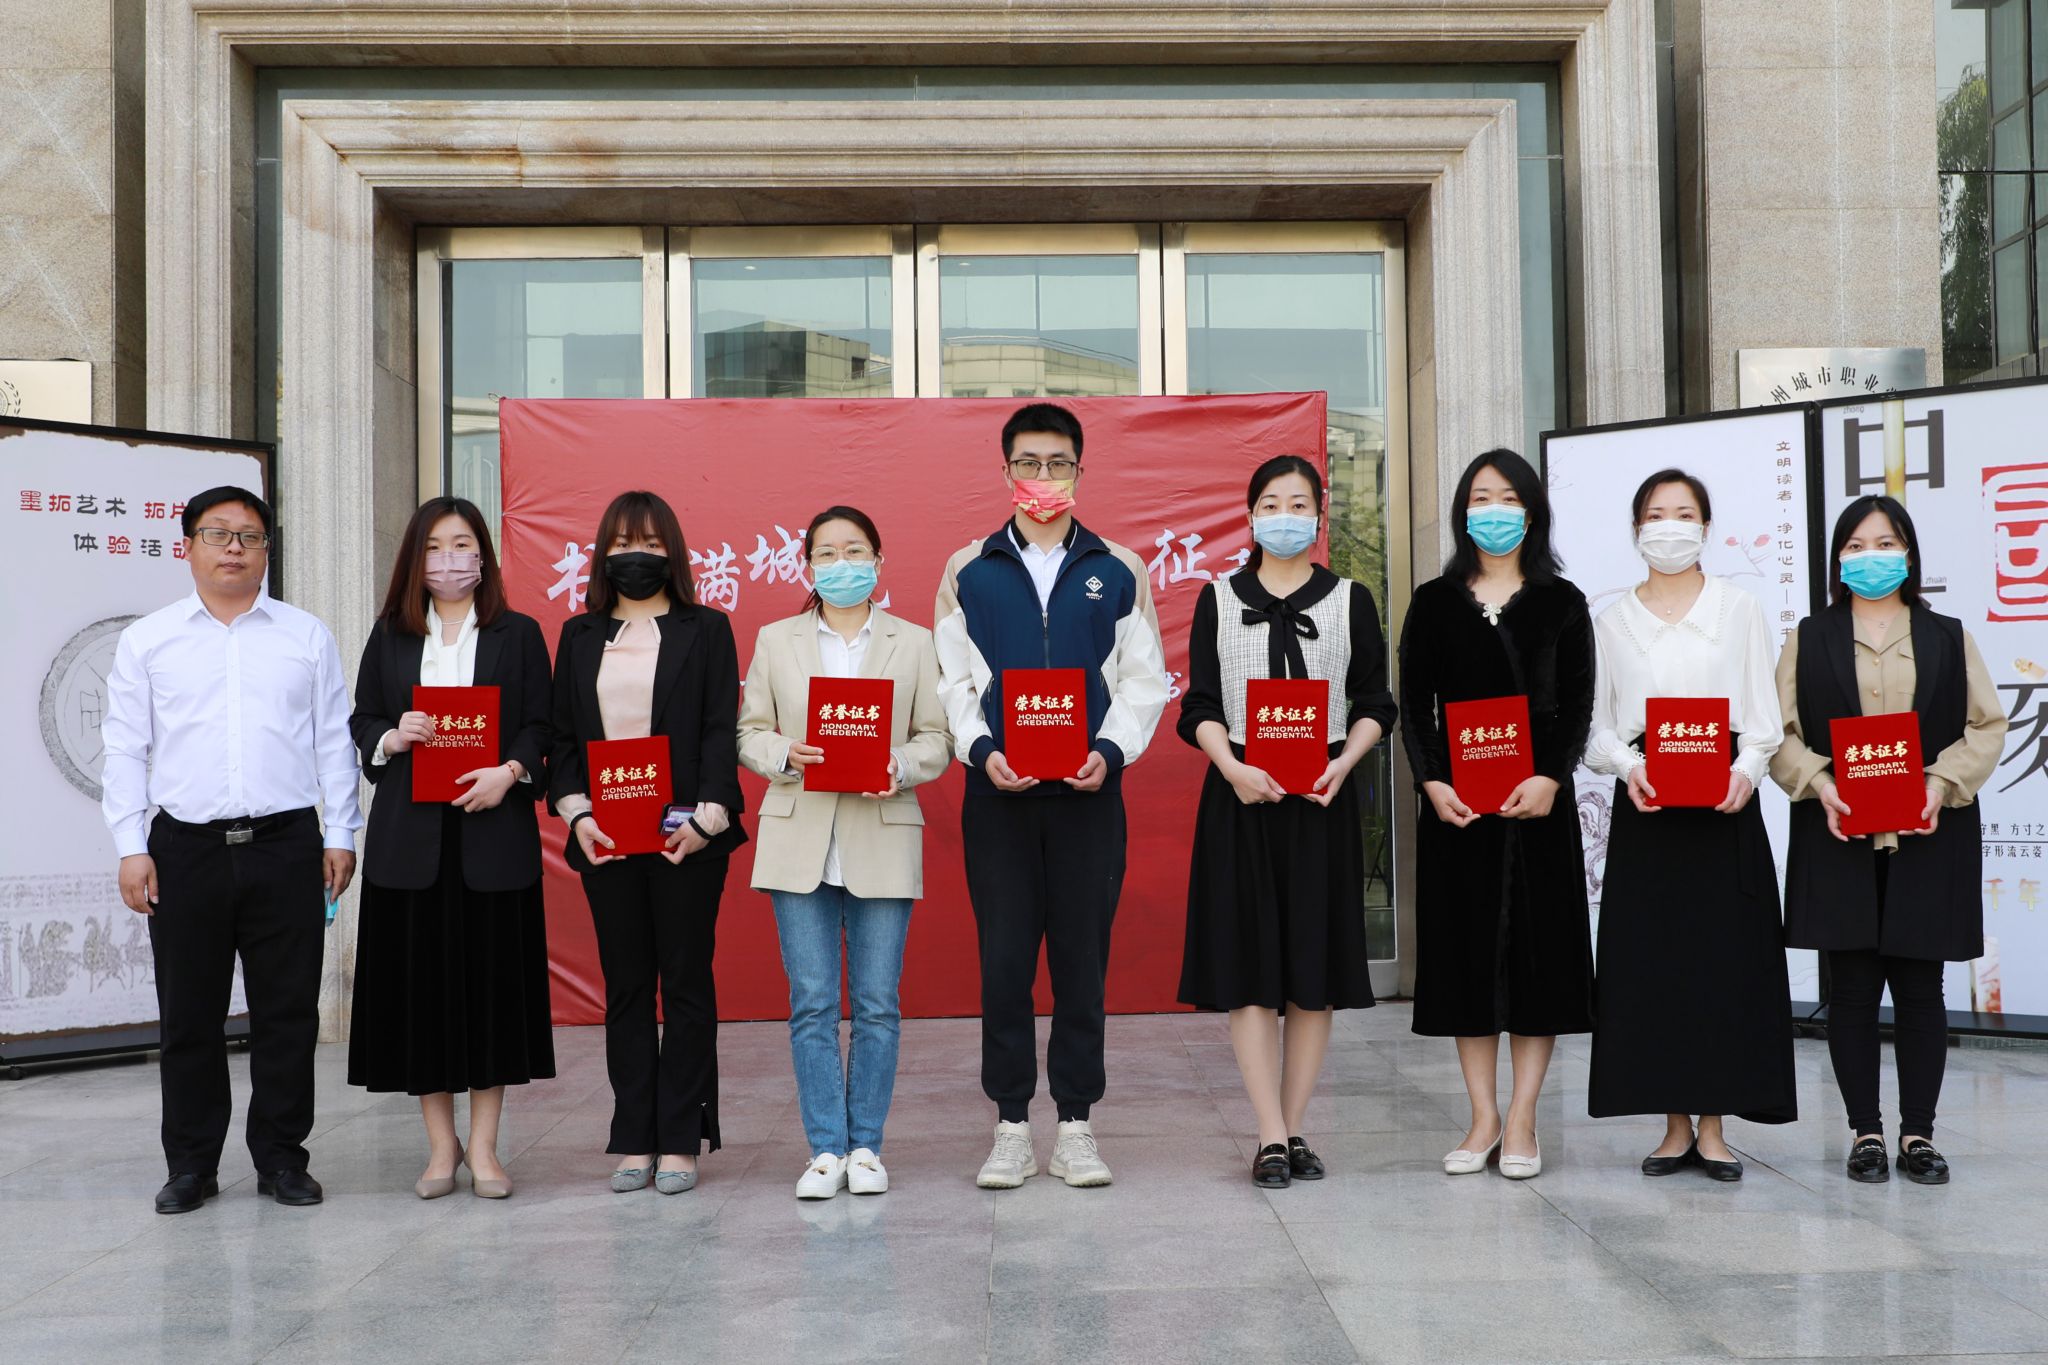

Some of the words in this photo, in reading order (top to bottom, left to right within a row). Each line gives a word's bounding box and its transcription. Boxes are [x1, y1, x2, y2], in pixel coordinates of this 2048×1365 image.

[1760, 366, 1897, 406] 州城市职业
[1843, 404, 1864, 414] zhong
[20, 490, 127, 518] 墨拓艺术
[1015, 694, 1074, 711] 荣誉证书
[819, 703, 880, 721] 荣誉证书
[1257, 706, 1316, 723] 荣誉证书
[819, 729, 878, 737] CREDENTIAL
[821, 722, 876, 731] HONORARY
[1658, 721, 1719, 738] 荣誉证书
[1460, 723, 1517, 745] 荣誉证书
[1462, 749, 1519, 760] CREDENTIAL
[1463, 743, 1516, 754] HONORARY
[1845, 740, 1907, 763] 荣誉证书
[1849, 761, 1905, 772] HONORARY
[599, 764, 657, 784] 荣誉证书
[1847, 768, 1909, 779] CREDENTIAL
[601, 790, 659, 800] CREDENTIAL
[603, 783, 655, 794] HONORARY
[2010, 823, 2045, 836] 方寸之
